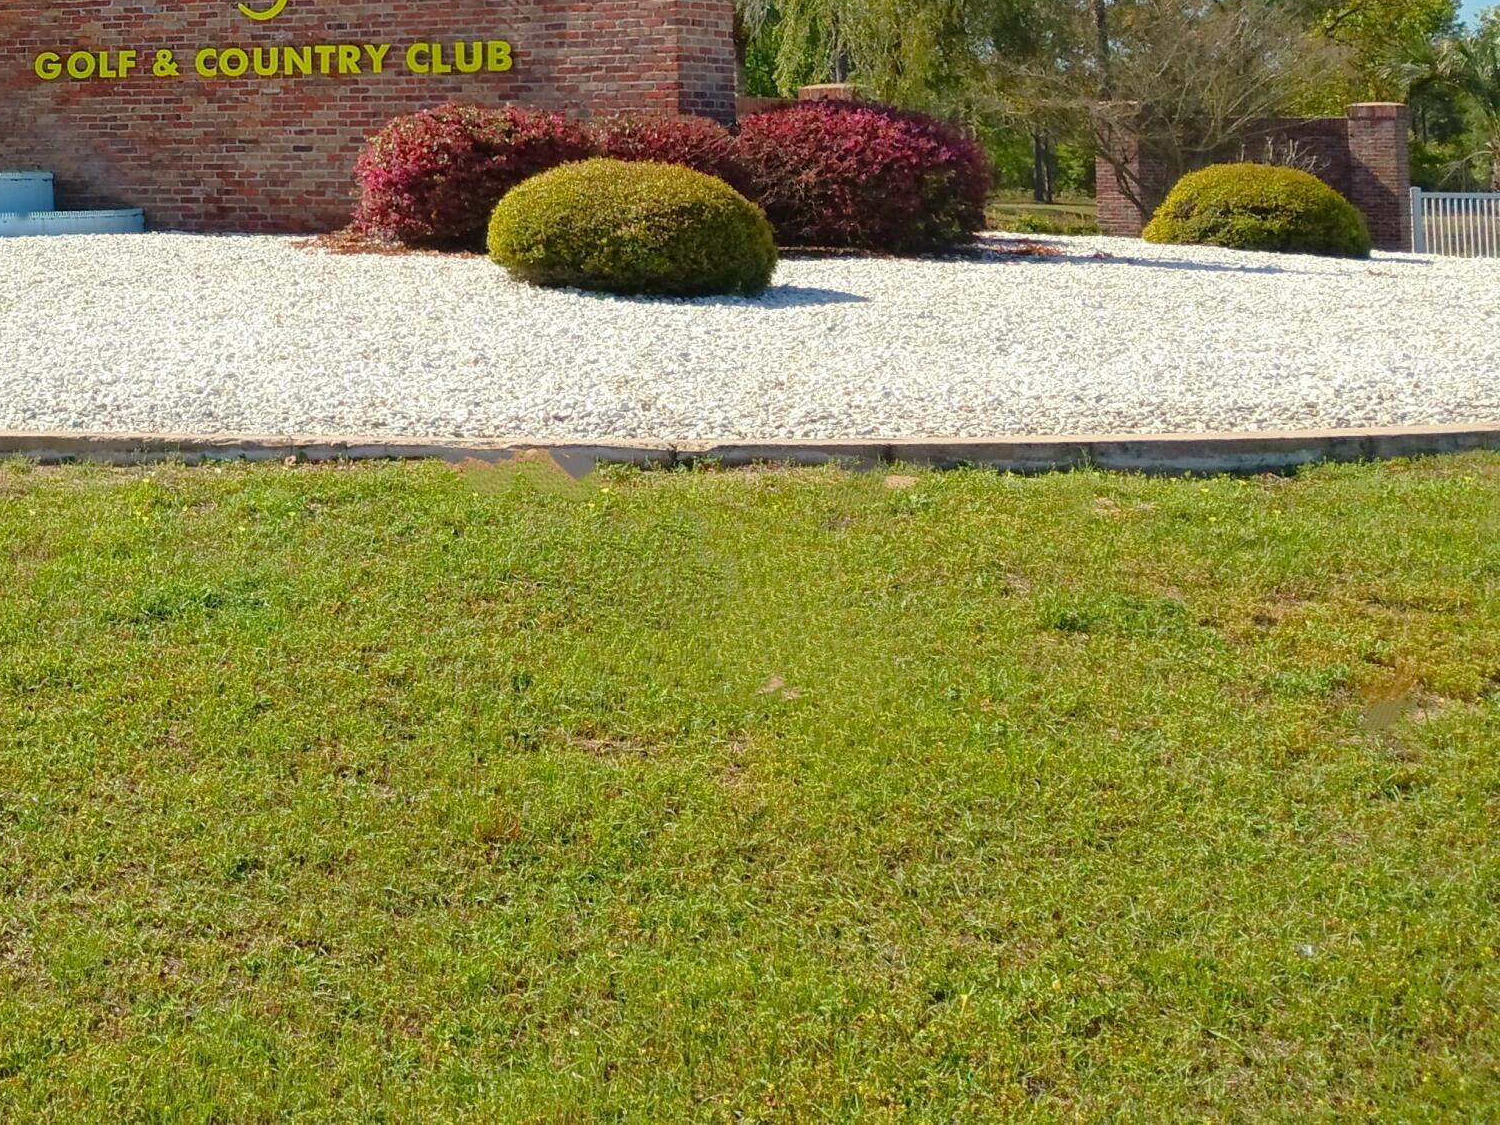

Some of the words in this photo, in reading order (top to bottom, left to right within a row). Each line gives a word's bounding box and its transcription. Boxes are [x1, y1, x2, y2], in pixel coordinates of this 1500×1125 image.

[33, 49, 138, 80] GOLF
[152, 48, 180, 78] &
[194, 42, 392, 78] COUNTRY
[404, 39, 514, 74] CLUB
